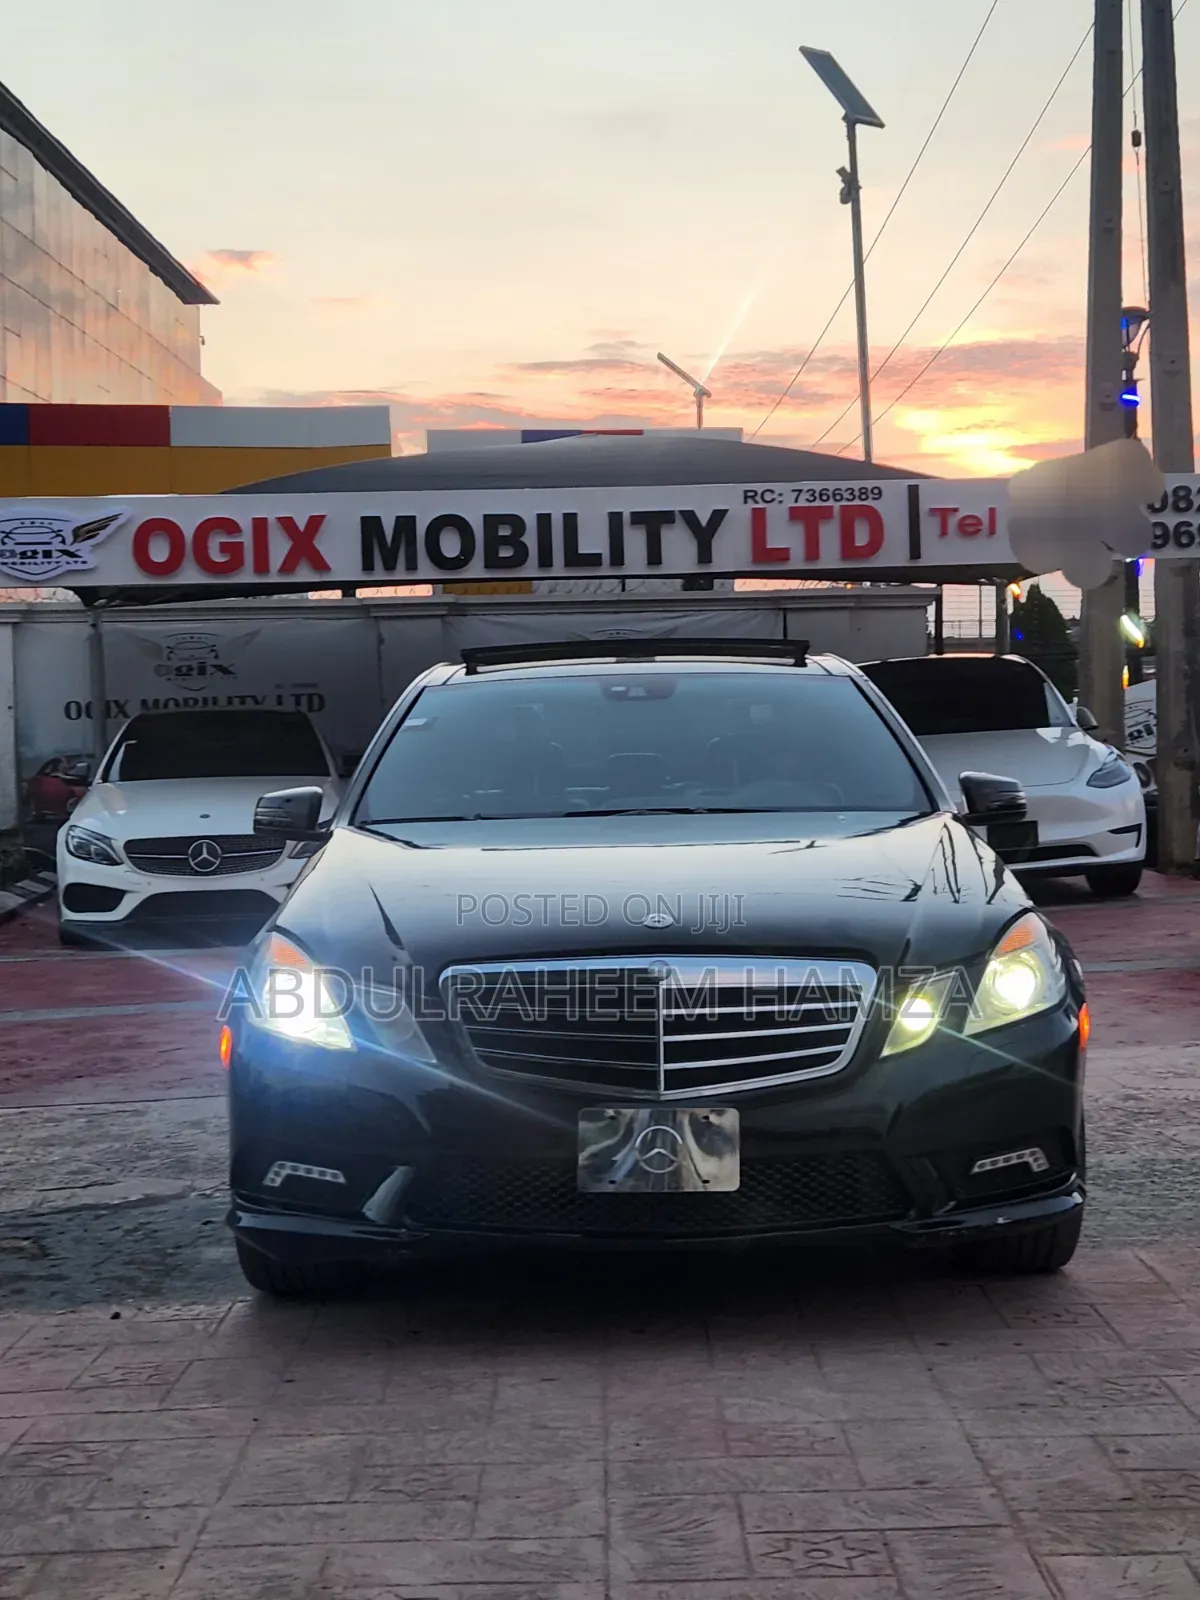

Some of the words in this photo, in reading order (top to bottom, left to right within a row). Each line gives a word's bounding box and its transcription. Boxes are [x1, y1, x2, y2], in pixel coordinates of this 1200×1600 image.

[743, 488, 784, 505] RC:
[791, 485, 883, 504] 7366389
[928, 506, 997, 537] Tel
[132, 514, 332, 576] OGIX
[360, 508, 730, 572] MOBILITY
[751, 503, 885, 564] LTD
